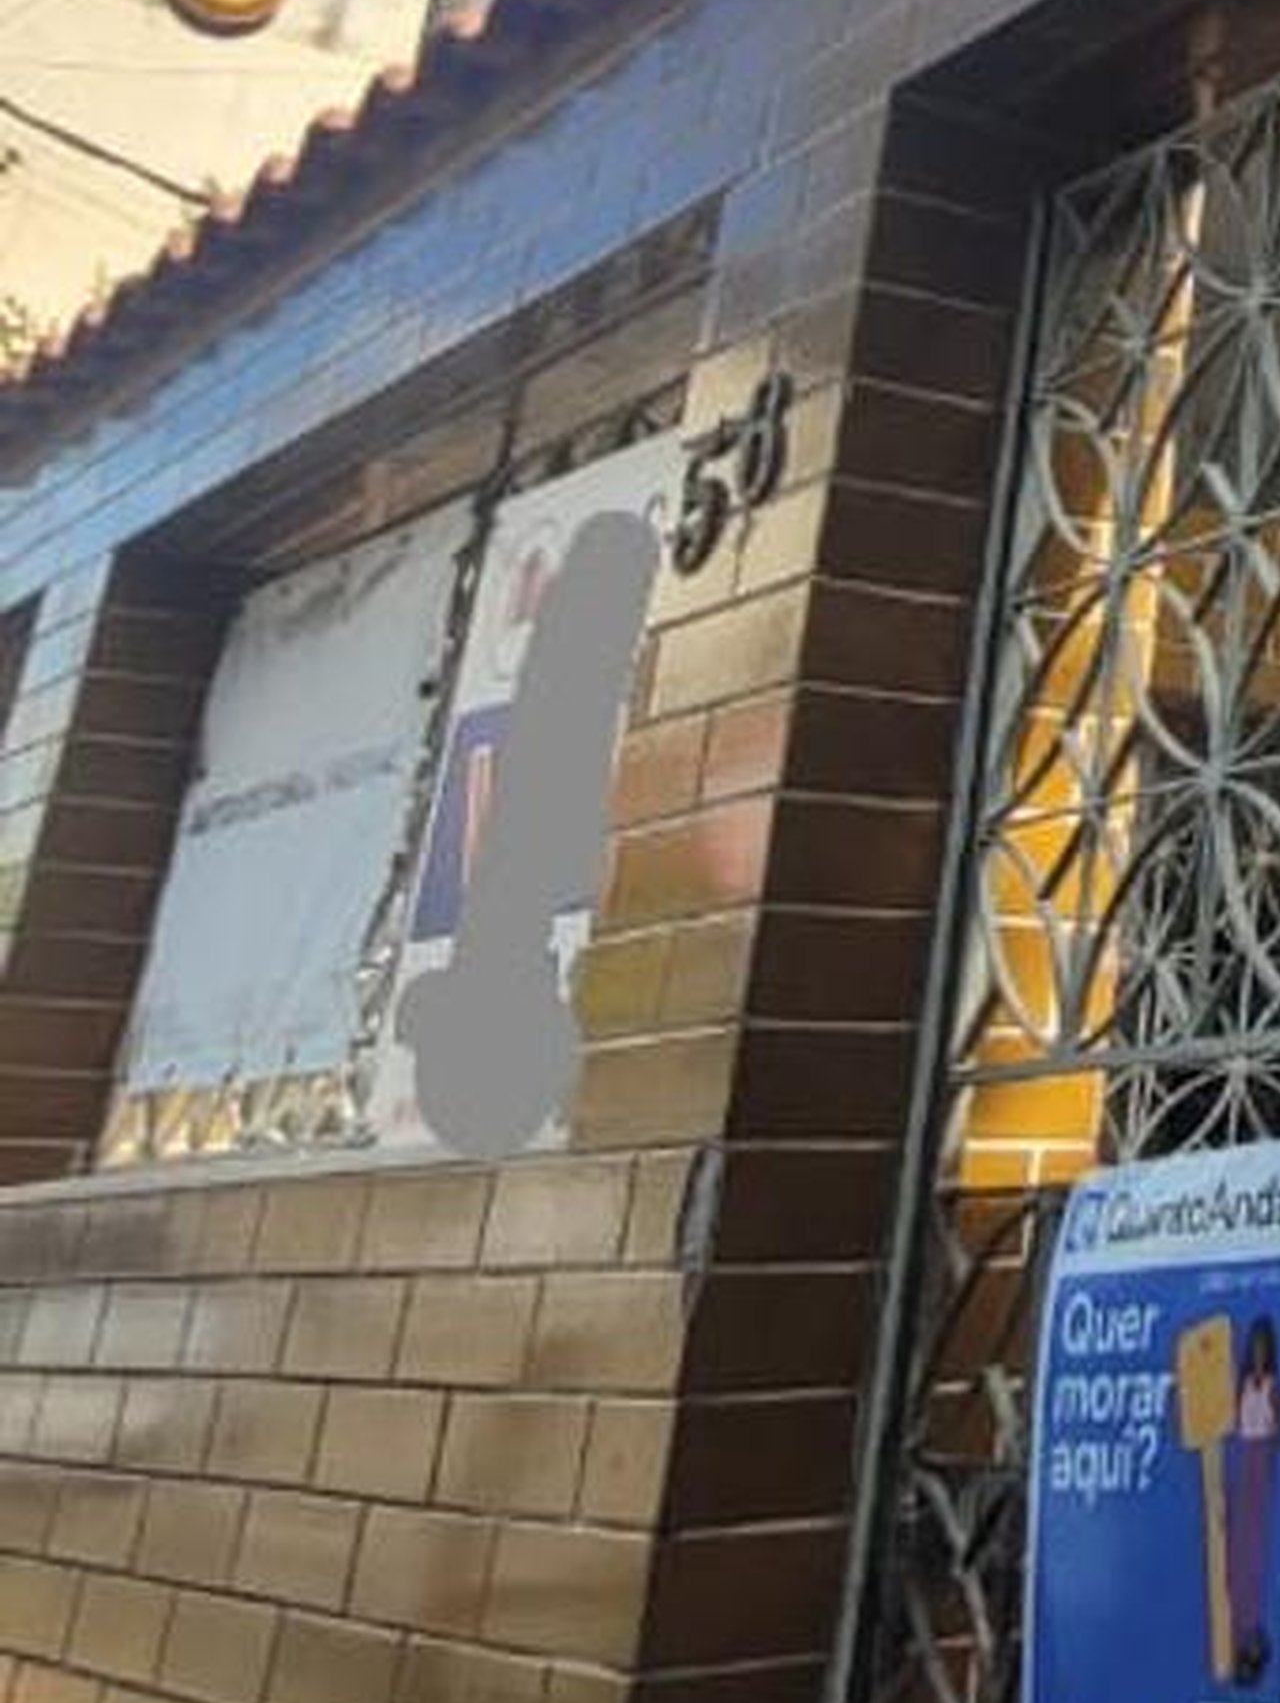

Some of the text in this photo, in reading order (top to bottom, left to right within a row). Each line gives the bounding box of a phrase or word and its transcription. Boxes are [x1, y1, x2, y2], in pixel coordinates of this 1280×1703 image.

[673, 373, 792, 575] 58
[1063, 1292, 1159, 1356] Quer
[1053, 1373, 1174, 1421] morar
[1051, 1423, 1156, 1507] aqui?
